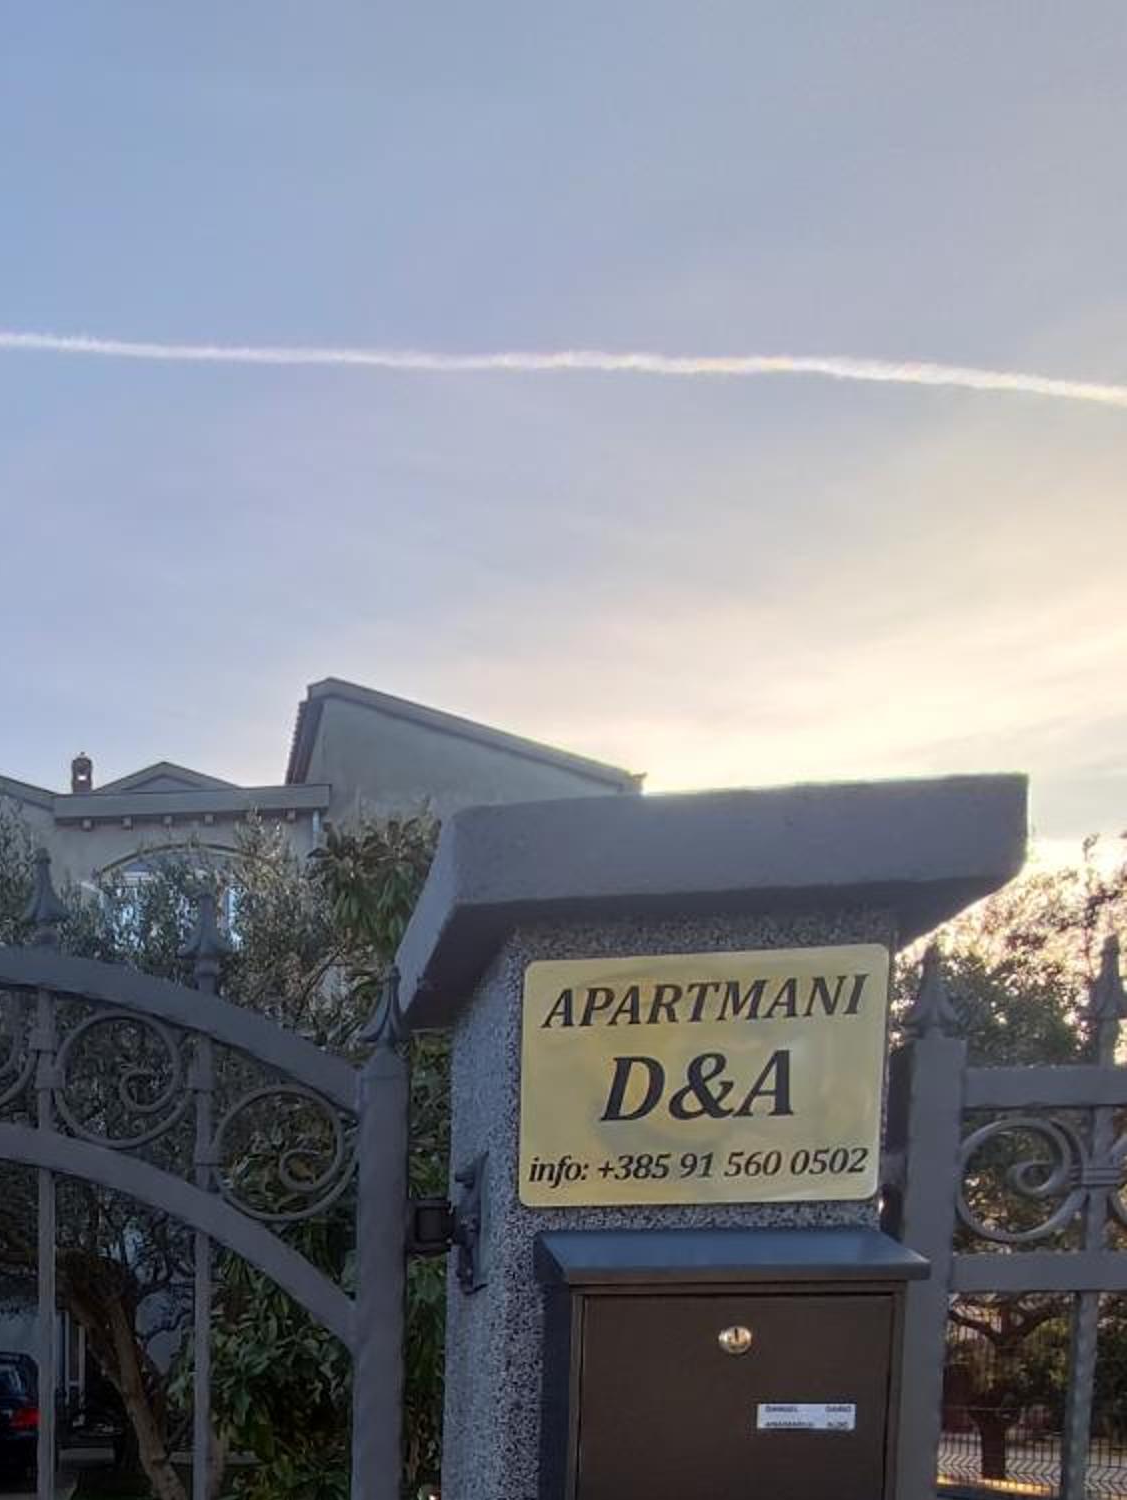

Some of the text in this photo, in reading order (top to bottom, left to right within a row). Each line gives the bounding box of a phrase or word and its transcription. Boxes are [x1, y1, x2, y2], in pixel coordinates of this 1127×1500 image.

[540, 973, 870, 1029] APARTMANI
[599, 1049, 795, 1122] D&A
[529, 1147, 869, 1188] info: +385 91 560 0502
